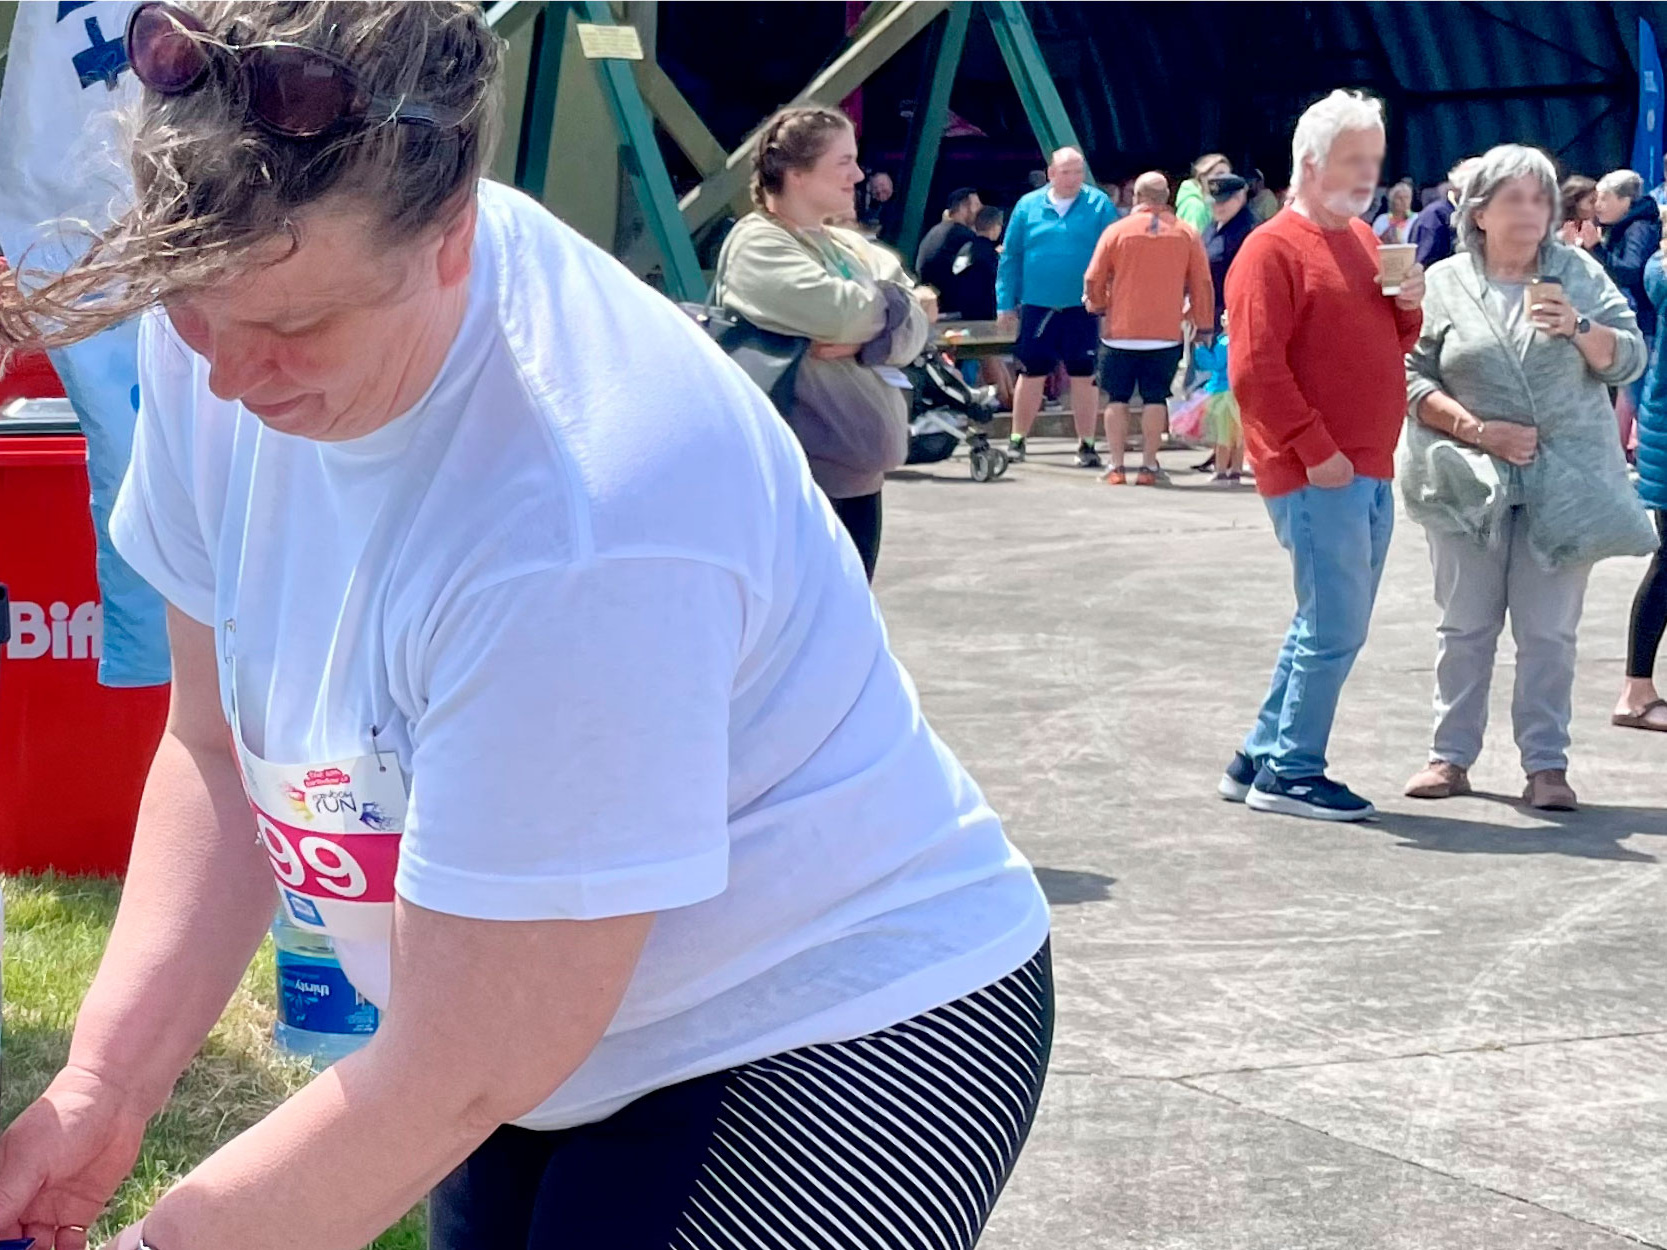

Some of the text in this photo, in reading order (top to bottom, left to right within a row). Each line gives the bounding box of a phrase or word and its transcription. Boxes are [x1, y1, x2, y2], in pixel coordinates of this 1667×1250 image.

[7, 601, 103, 659] Biff
[257, 813, 367, 898] 99
[289, 979, 330, 998] thirsty
